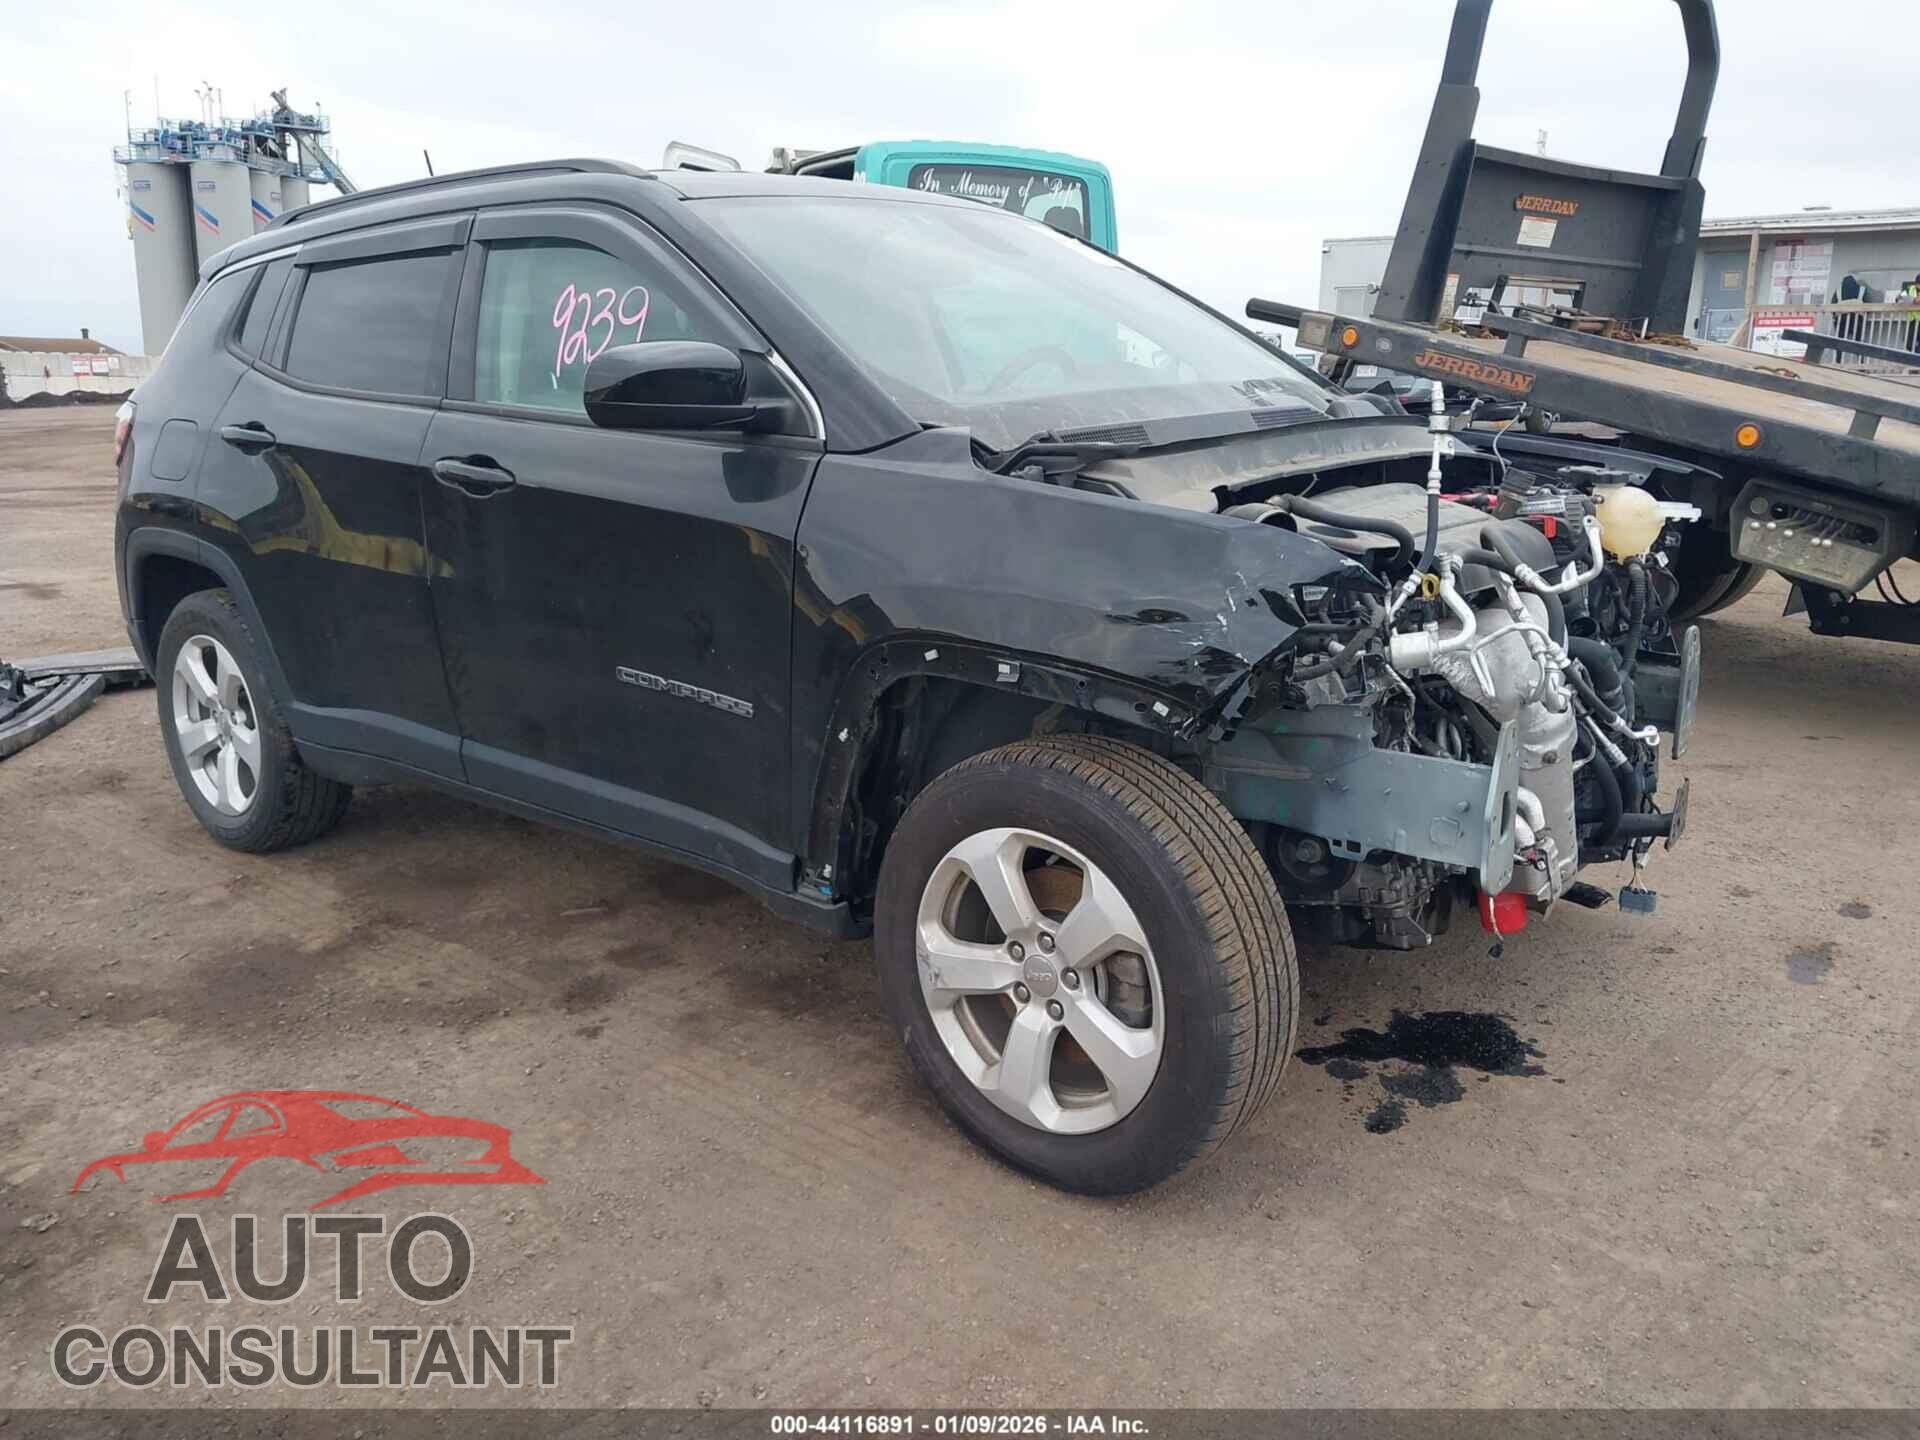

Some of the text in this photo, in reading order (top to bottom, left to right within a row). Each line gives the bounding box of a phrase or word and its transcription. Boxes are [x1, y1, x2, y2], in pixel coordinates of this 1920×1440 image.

[919, 168, 940, 193] In
[950, 171, 1010, 207] Memory
[1017, 176, 1035, 208] of
[553, 283, 650, 378] 9239
[616, 666, 754, 718] COMPASS
